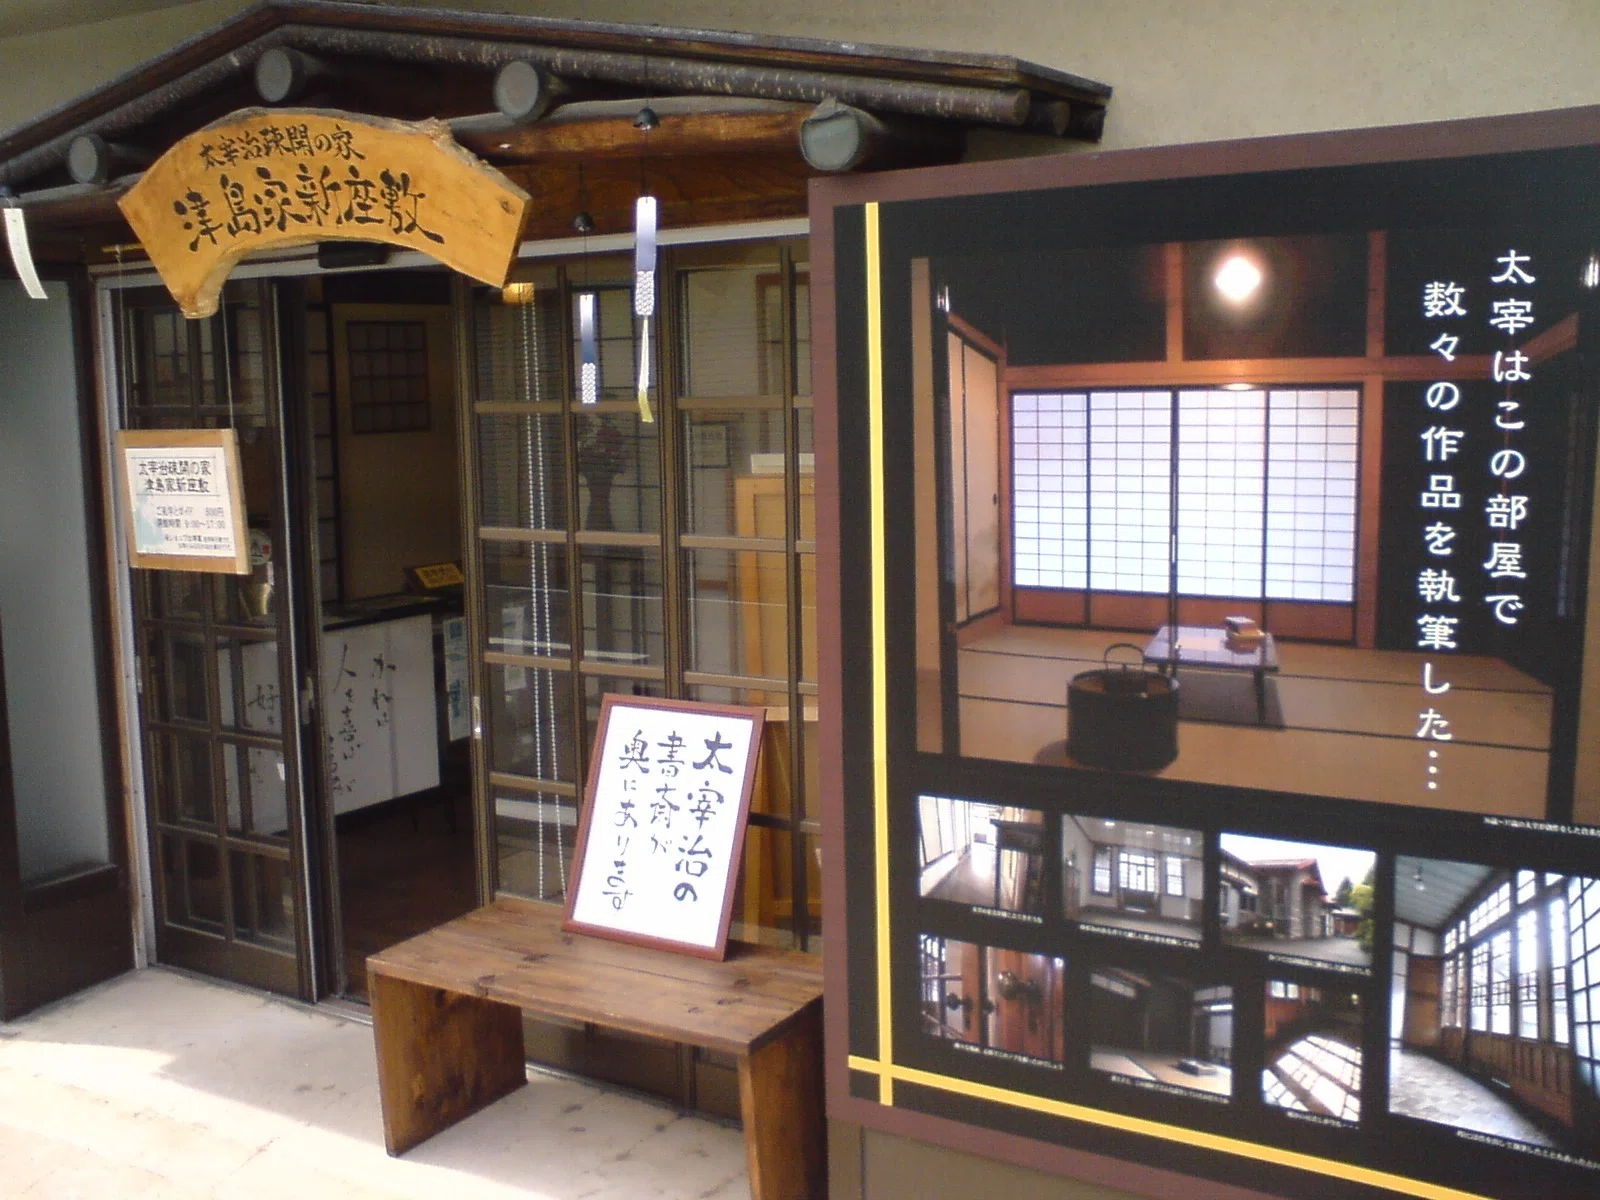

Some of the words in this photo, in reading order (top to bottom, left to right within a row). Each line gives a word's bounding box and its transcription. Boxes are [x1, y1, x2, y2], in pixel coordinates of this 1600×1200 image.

[174, 164, 444, 252] 津島家新座敷
[199, 124, 365, 169] 太宰治疎開の家
[1483, 249, 1536, 625] 太宰はこの部屋で
[603, 730, 650, 911] 奥にあります
[651, 731, 686, 854] 書斎が
[675, 732, 733, 902] 太宰治の
